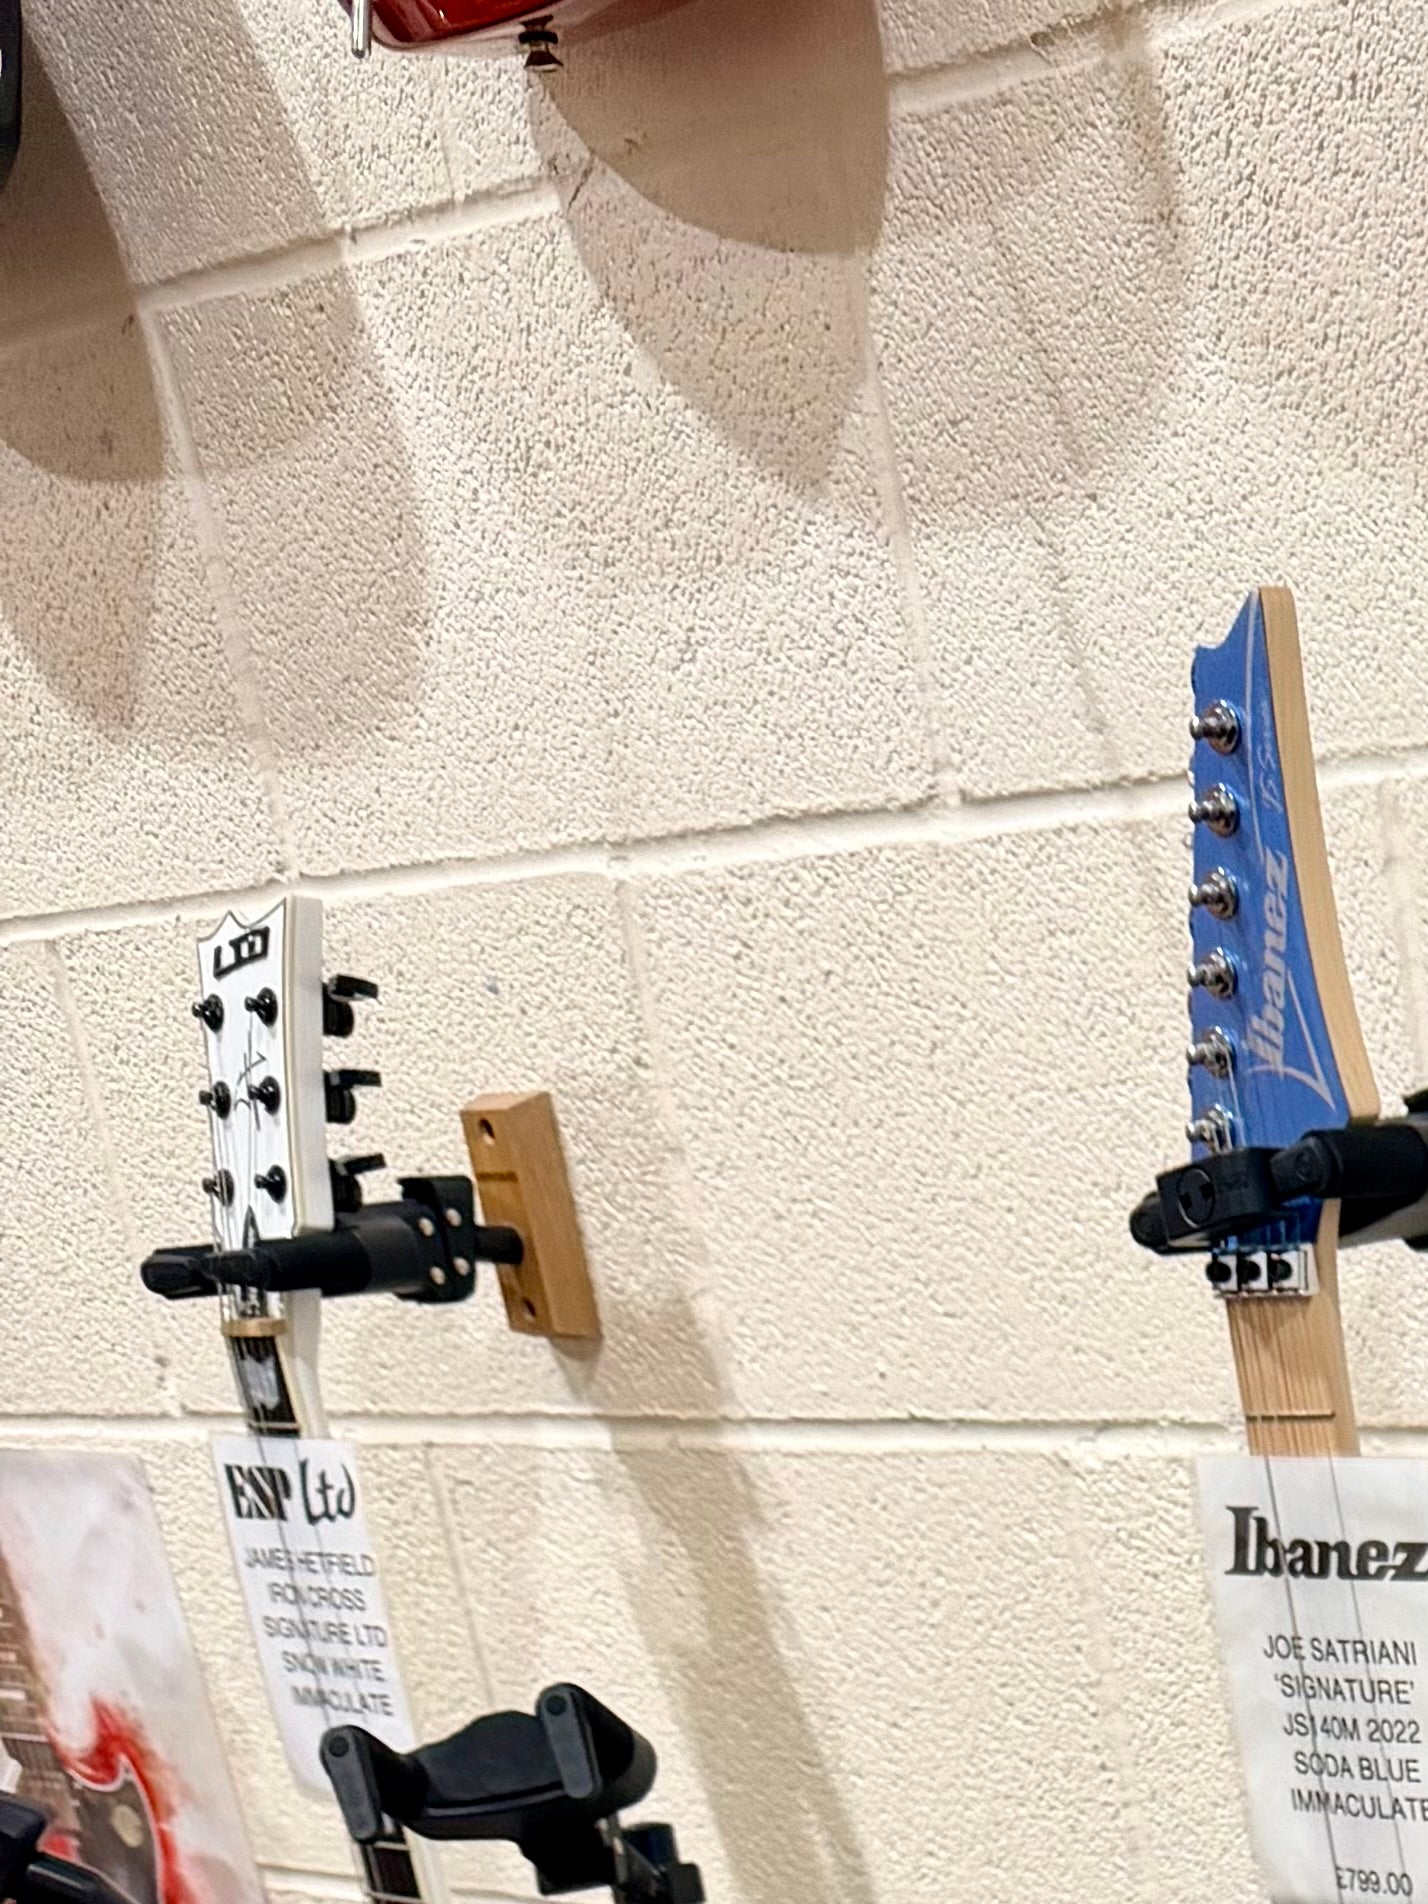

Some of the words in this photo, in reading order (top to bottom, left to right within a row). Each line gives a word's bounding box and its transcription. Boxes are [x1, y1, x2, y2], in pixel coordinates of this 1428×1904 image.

[1246, 847, 1289, 1079] Ibanez
[224, 1463, 292, 1522] ESP
[299, 1457, 356, 1526] Ltd
[355, 1625, 387, 1648] LTD
[1264, 1635, 1307, 1661] JOE
[1310, 1637, 1418, 1666] SATRIANI
[330, 1657, 385, 1682] WHITE
[292, 1685, 394, 1717] IMMACULATE
[1367, 1719, 1422, 1744] 2022
[1294, 1751, 1354, 1779] SODA
[1359, 1757, 1422, 1784] BLUE
[1336, 1865, 1413, 1897] £799.00
